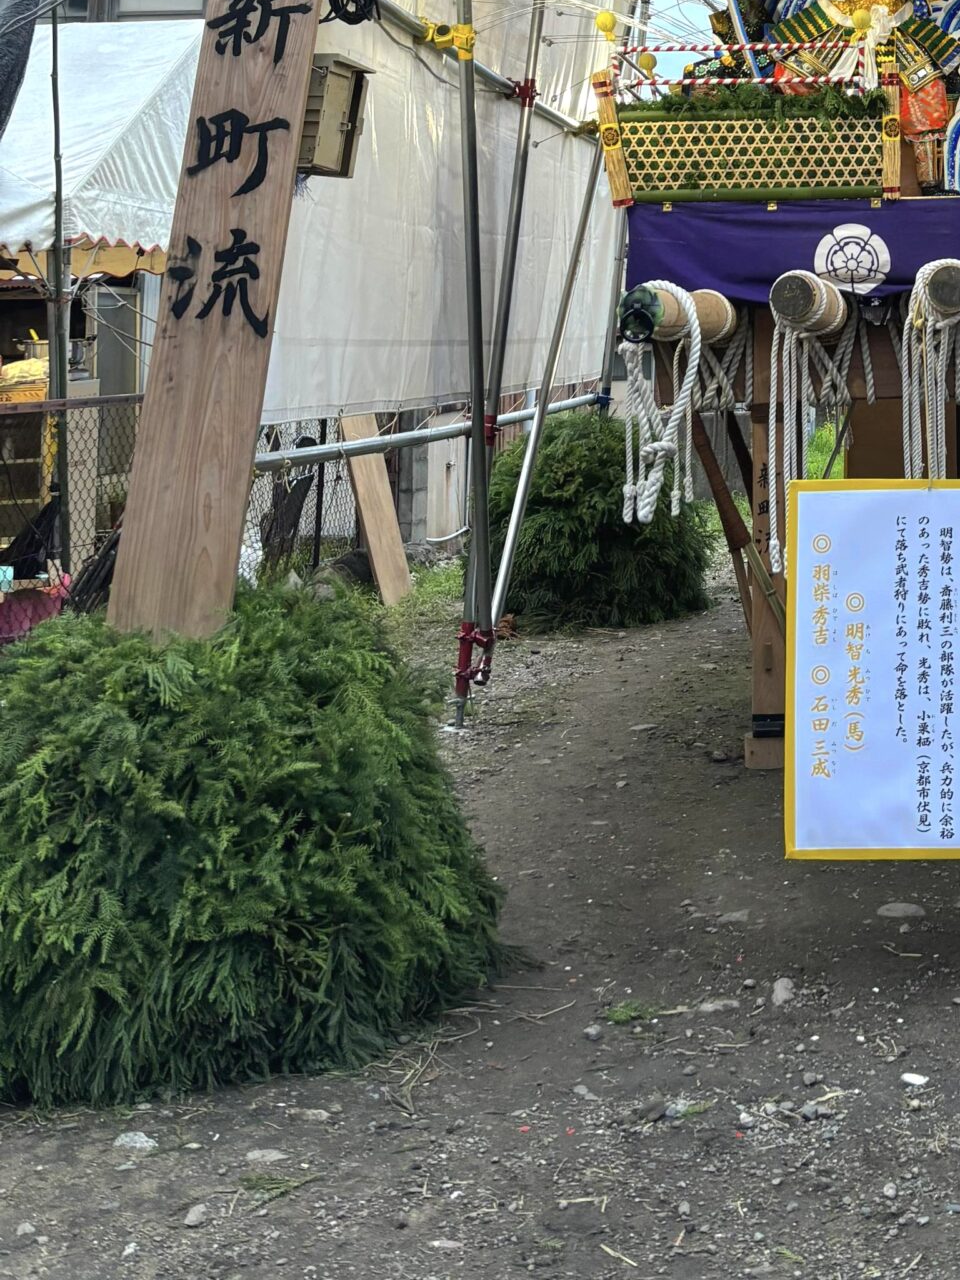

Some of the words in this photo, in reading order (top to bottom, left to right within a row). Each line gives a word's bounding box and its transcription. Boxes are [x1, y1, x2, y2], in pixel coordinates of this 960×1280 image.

[811, 563, 831, 646] 羽柴秀吉
[894, 516, 909, 743] にて落ち武者狩りにあって命を落とした。
[810, 695, 832, 779] 石田三成
[844, 622, 866, 752] 明智光秀（馬）
